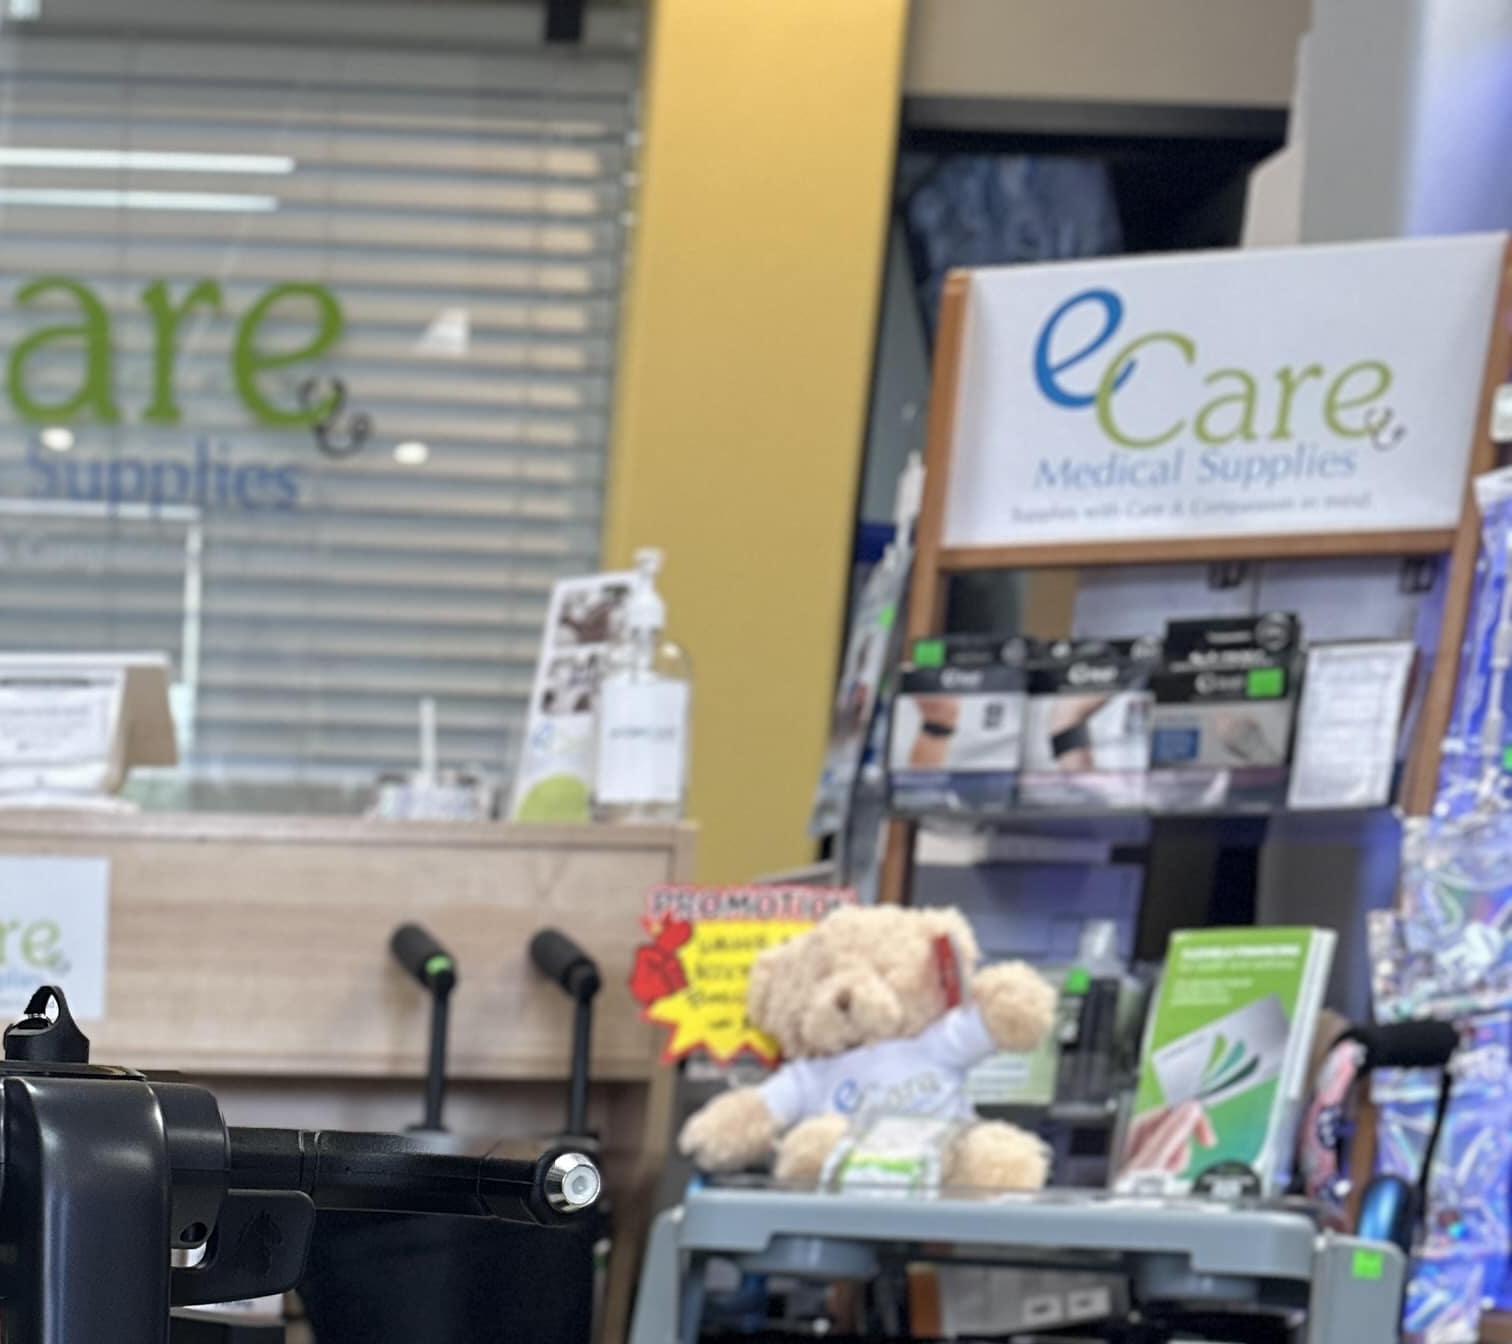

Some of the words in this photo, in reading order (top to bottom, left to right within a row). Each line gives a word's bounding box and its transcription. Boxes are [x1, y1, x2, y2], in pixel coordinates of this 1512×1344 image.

[26, 430, 303, 512] Supplies
[1033, 448, 1186, 491] Medical
[1196, 443, 1358, 491] Supplies
